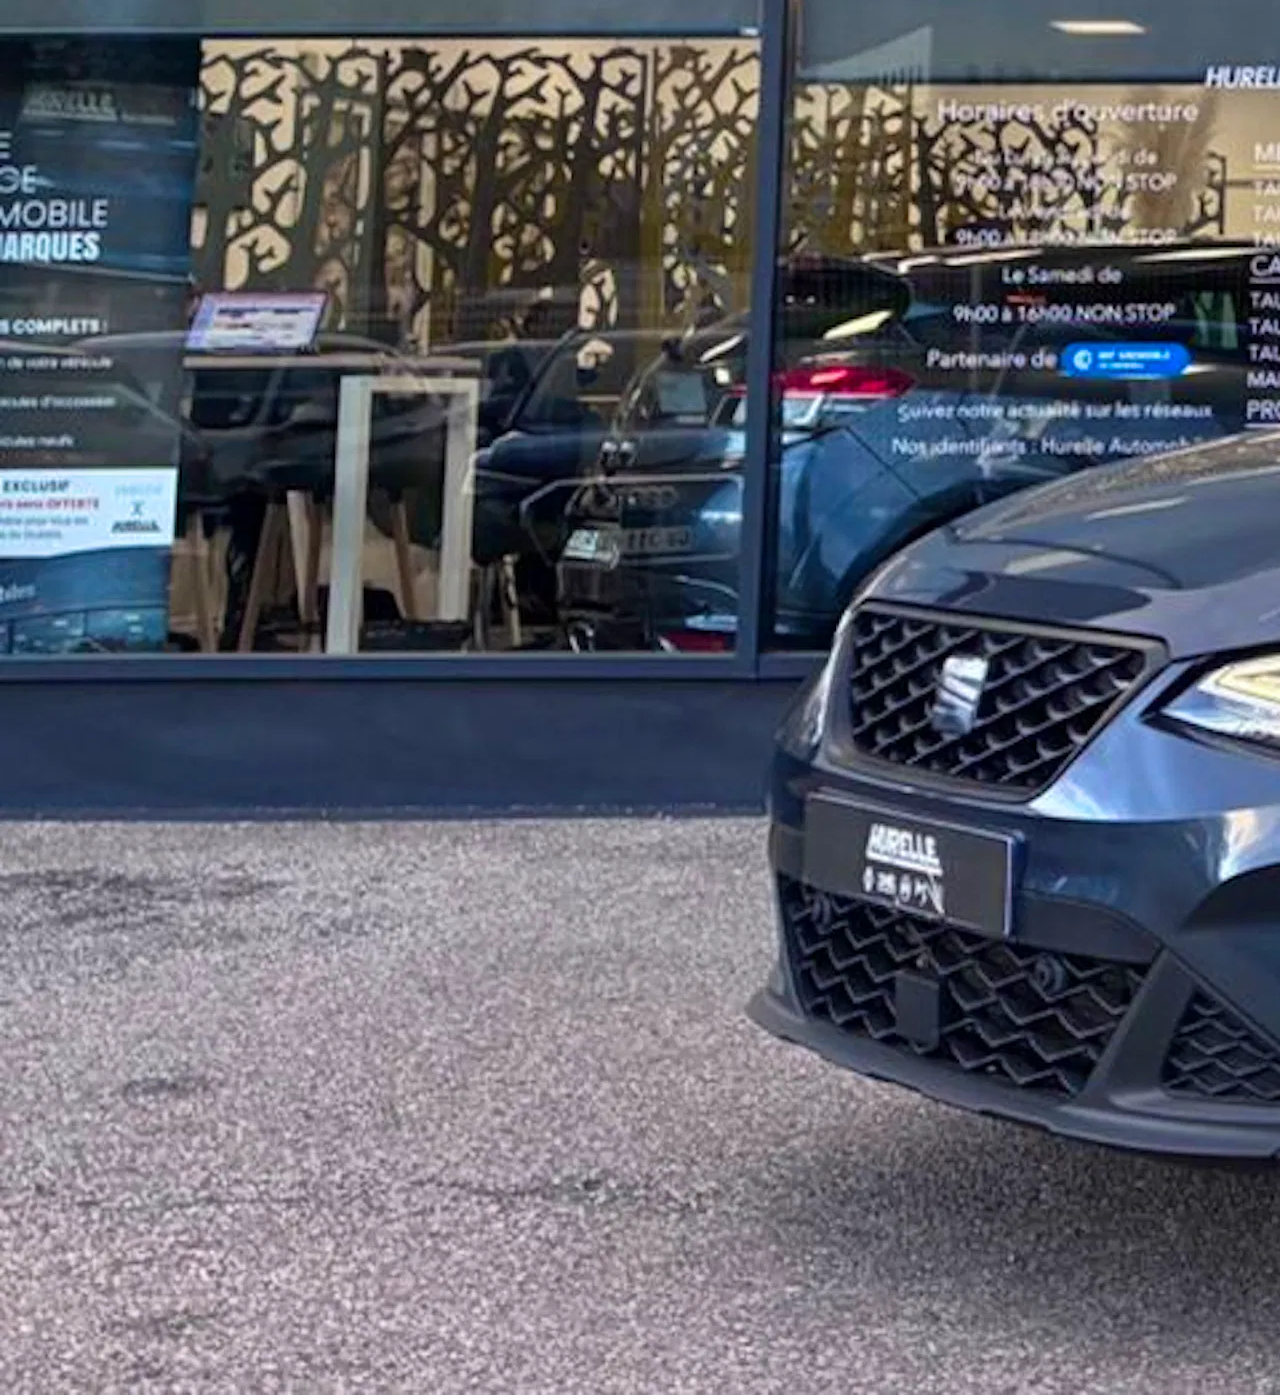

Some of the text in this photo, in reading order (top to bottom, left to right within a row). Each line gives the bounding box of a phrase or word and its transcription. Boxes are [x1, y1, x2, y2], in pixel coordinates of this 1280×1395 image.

[938, 99, 1198, 121] Horaires d'ouverture
[0, 230, 100, 263] ARQUES
[1002, 265, 1123, 284] Le Samedi de
[953, 304, 998, 323] 9h00
[1076, 304, 1121, 323] NON
[1124, 303, 1176, 323] STOP
[926, 347, 1057, 369] Partenaire de
[898, 403, 953, 422] Suivez
[958, 403, 1001, 419] notre
[1086, 404, 1111, 419] sur
[1115, 401, 1140, 419] les
[892, 439, 924, 456] Nos
[865, 822, 944, 877] HURELLE
